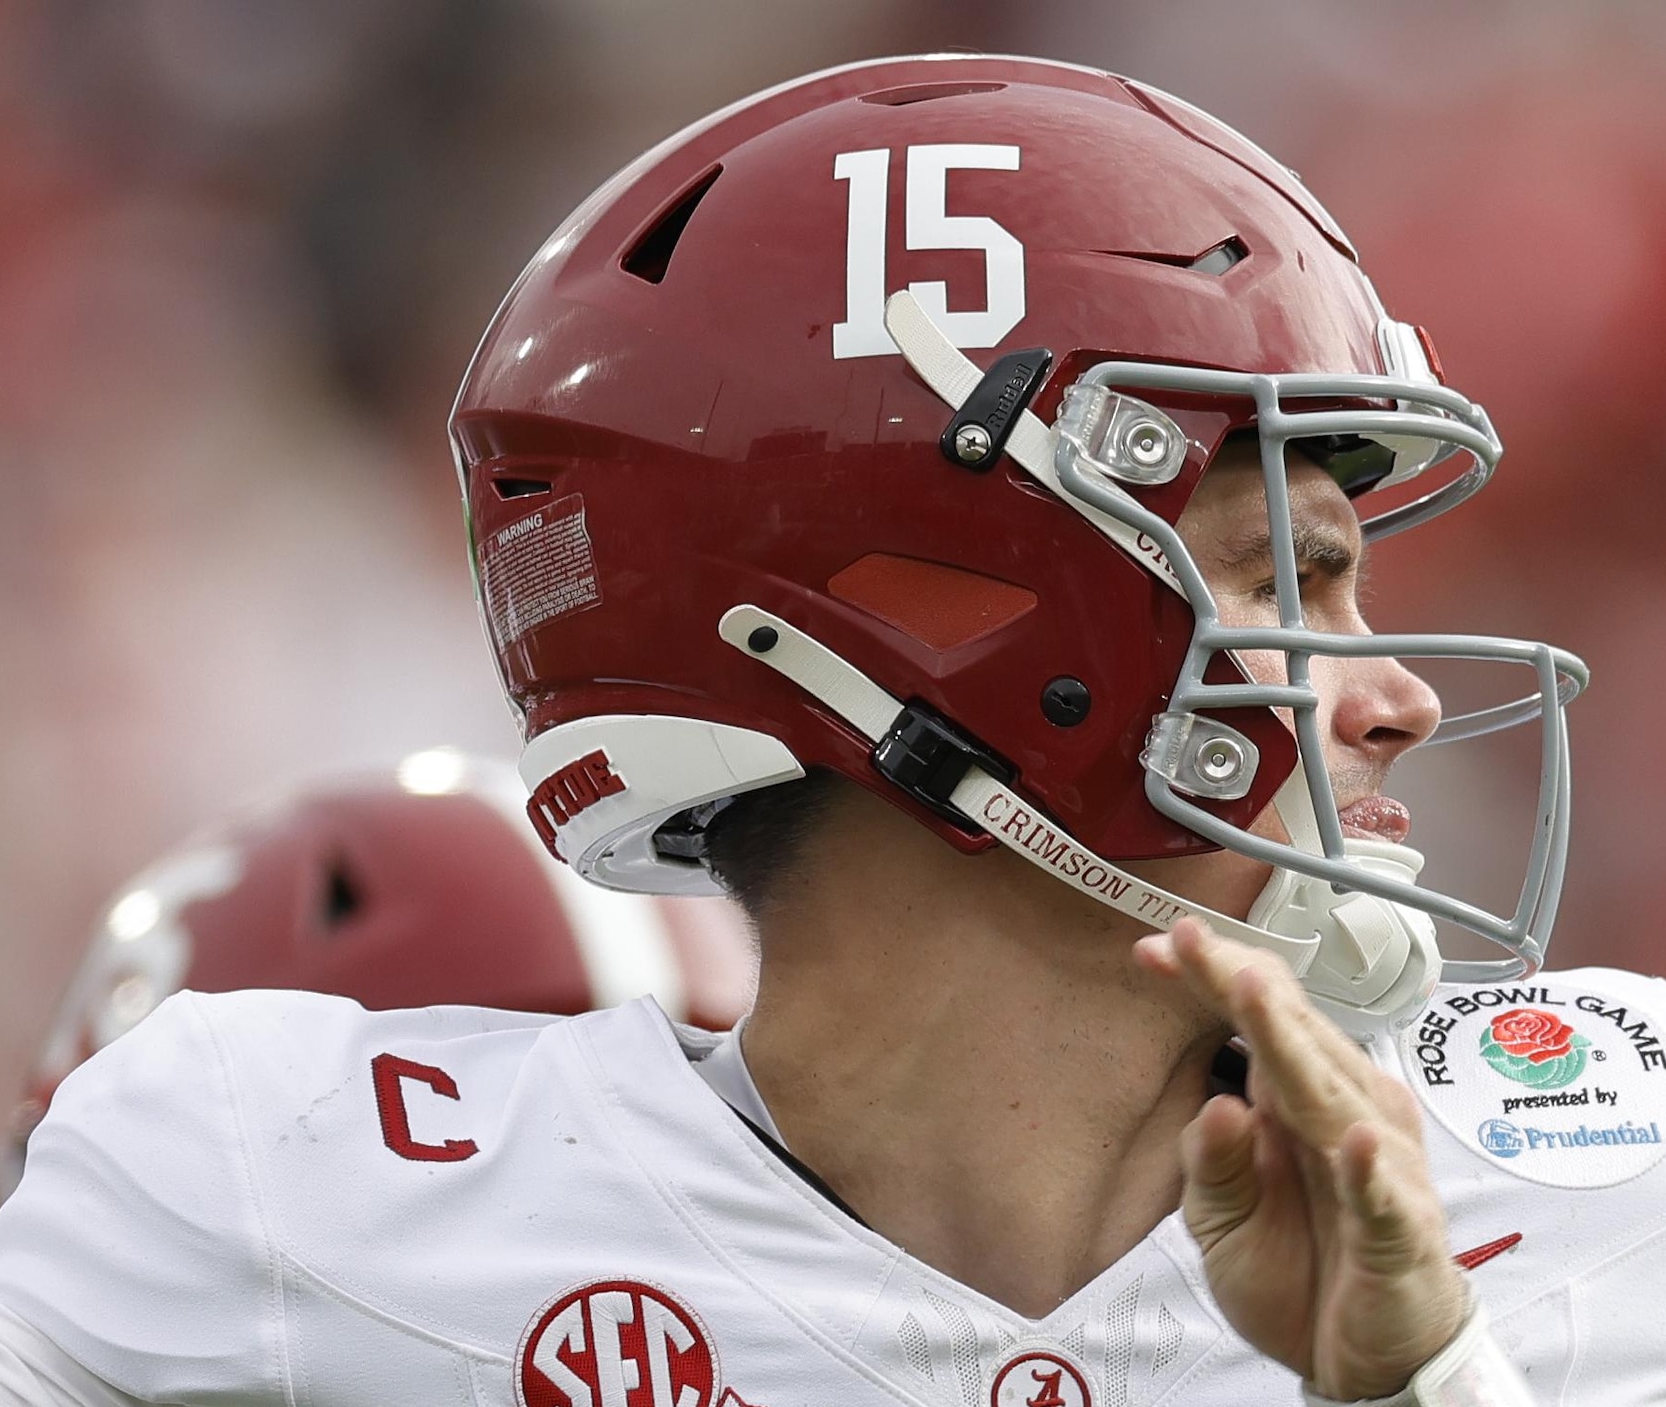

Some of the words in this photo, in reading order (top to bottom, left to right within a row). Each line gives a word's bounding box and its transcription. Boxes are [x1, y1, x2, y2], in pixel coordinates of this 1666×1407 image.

[833, 144, 1026, 359] 15
[497, 513, 543, 546] WARNING
[983, 793, 1133, 900] CRIMSON
[1417, 1011, 1456, 1087] ROSE
[1445, 987, 1566, 1017] BOWL
[371, 1053, 481, 1163] C
[1502, 1087, 1590, 1114] presented
[1595, 1087, 1618, 1107] by
[1525, 1121, 1662, 1150] Prudential
